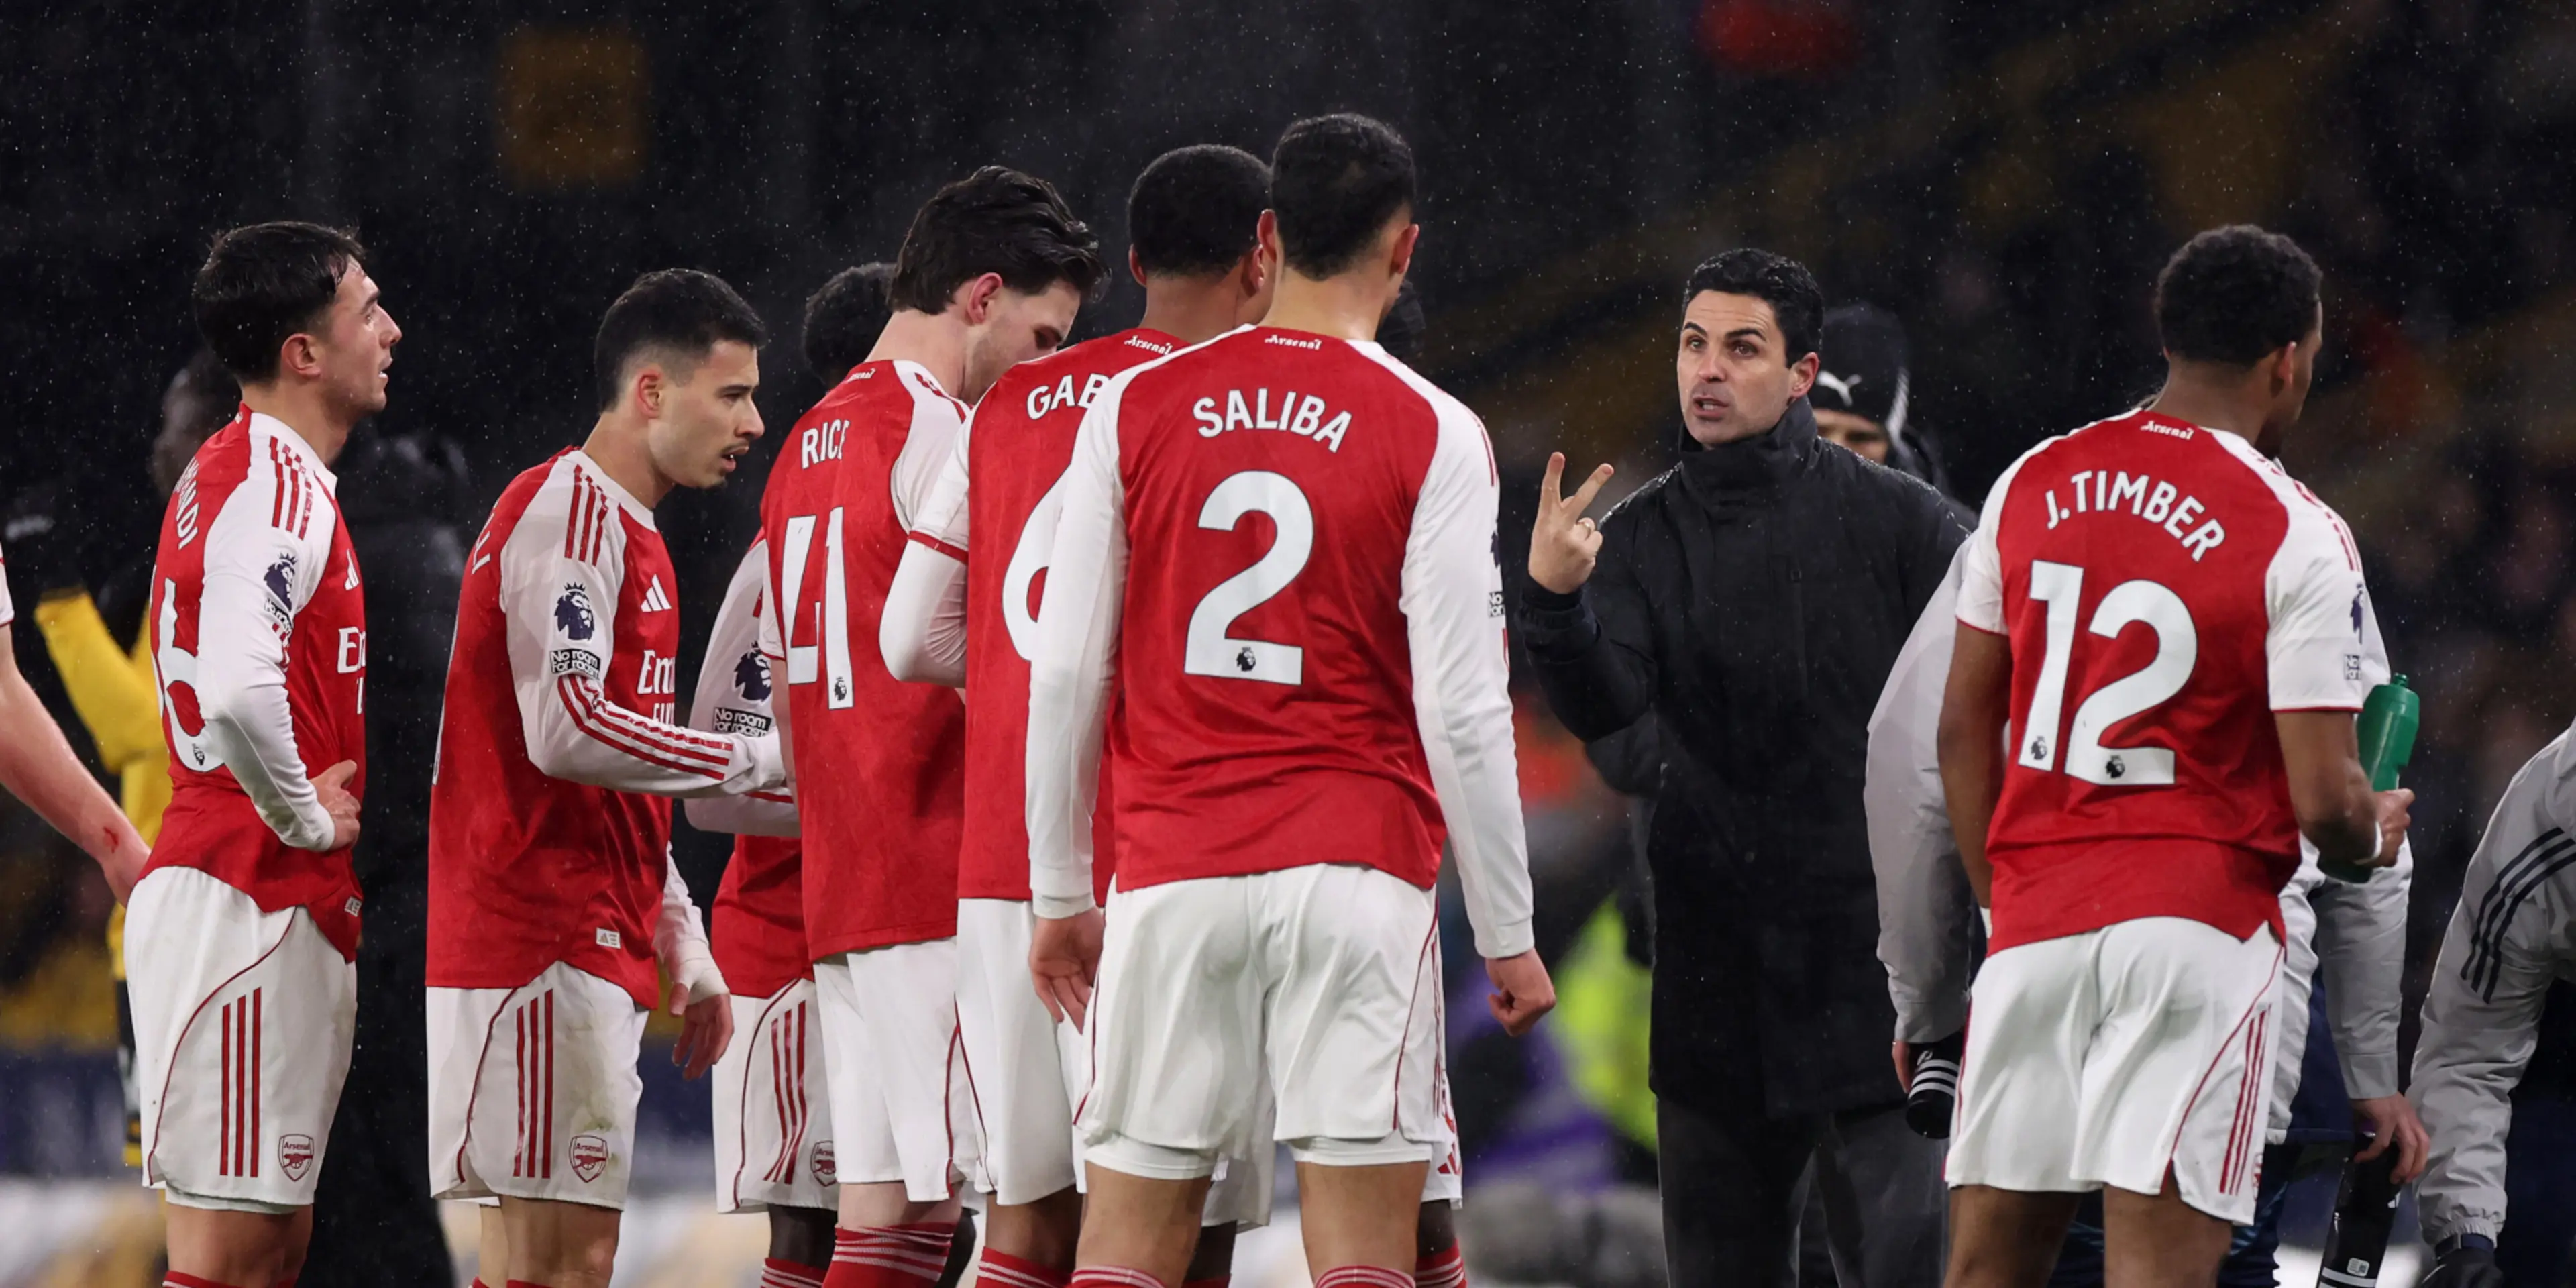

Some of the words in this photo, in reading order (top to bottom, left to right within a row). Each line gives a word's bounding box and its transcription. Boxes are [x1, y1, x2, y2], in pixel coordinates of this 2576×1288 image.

[1124, 335, 1173, 355] Arsenal
[1264, 334, 1322, 350] Arsenal
[1192, 388, 1352, 454] SALIBA
[2139, 419, 2195, 440] Arsenal
[782, 506, 853, 710] 41
[1184, 469, 1314, 686] 2
[2018, 559, 2198, 786] 12
